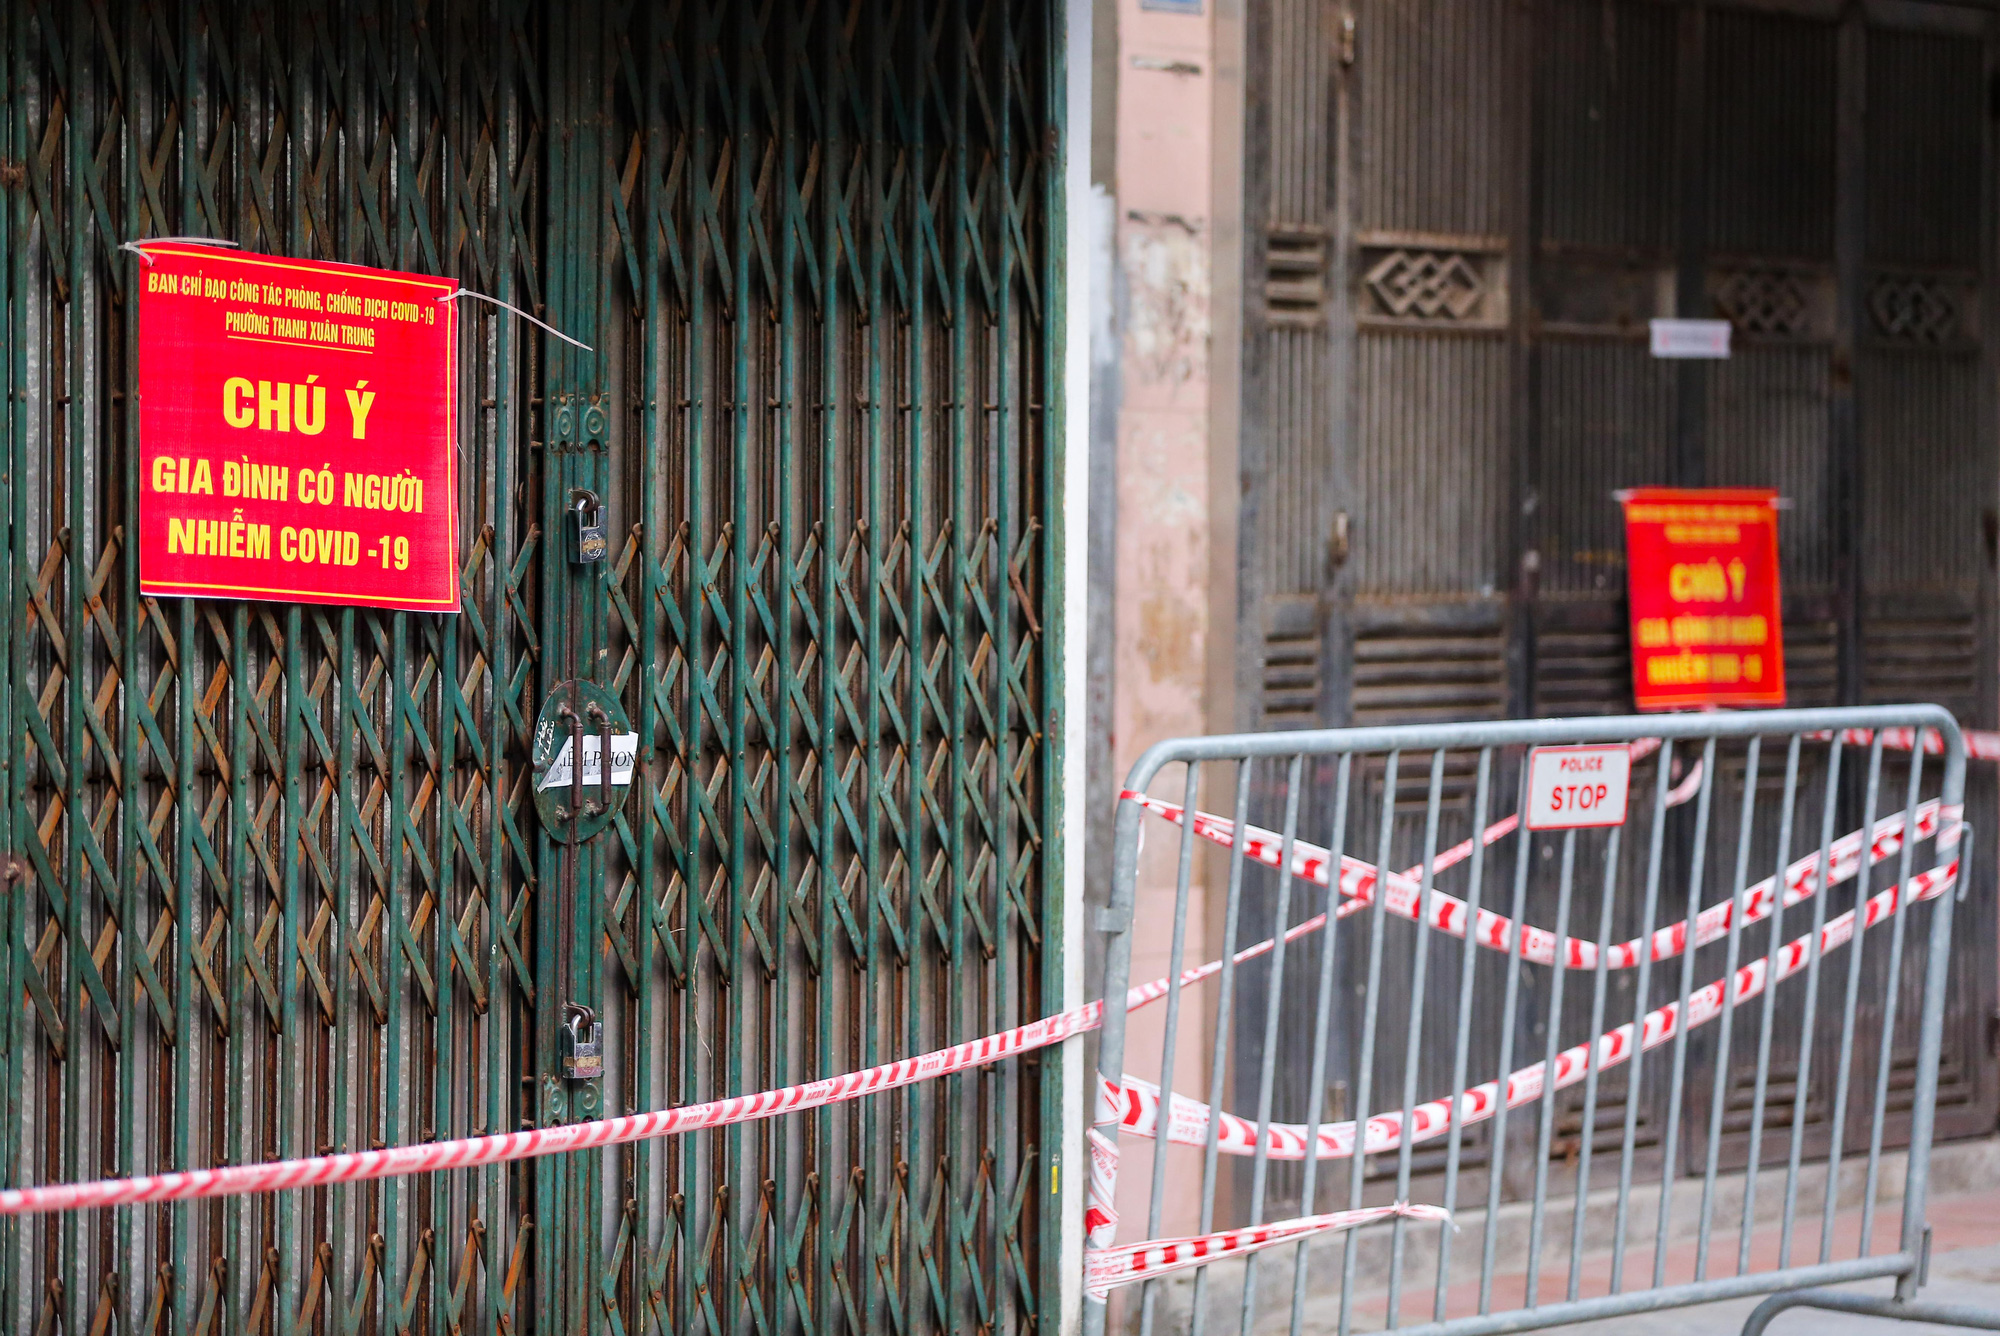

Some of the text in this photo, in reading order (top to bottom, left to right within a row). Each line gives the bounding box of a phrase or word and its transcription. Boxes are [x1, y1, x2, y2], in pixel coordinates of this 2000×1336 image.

[148, 272, 178, 294] BAN
[182, 270, 202, 297] CHỈ
[205, 278, 227, 303] ĐẠO
[230, 278, 260, 304] CÔNG
[262, 281, 283, 306] TÁC
[285, 285, 324, 314] PHÒNG,
[326, 287, 361, 317] CHỐNG
[364, 298, 388, 322] DỊCH
[391, 301, 419, 323] COVID
[225, 309, 375, 348] PHƯỜNG THANH XUÂN TRUNG
[223, 374, 376, 440] CHÚ Ý
[152, 455, 423, 513] GIA ĐÌNH CÓ NGƯỜI
[167, 508, 410, 571] NHIỄM COVID -19
[1560, 756, 1603, 772] POLICE
[1551, 784, 1608, 811] STOP
